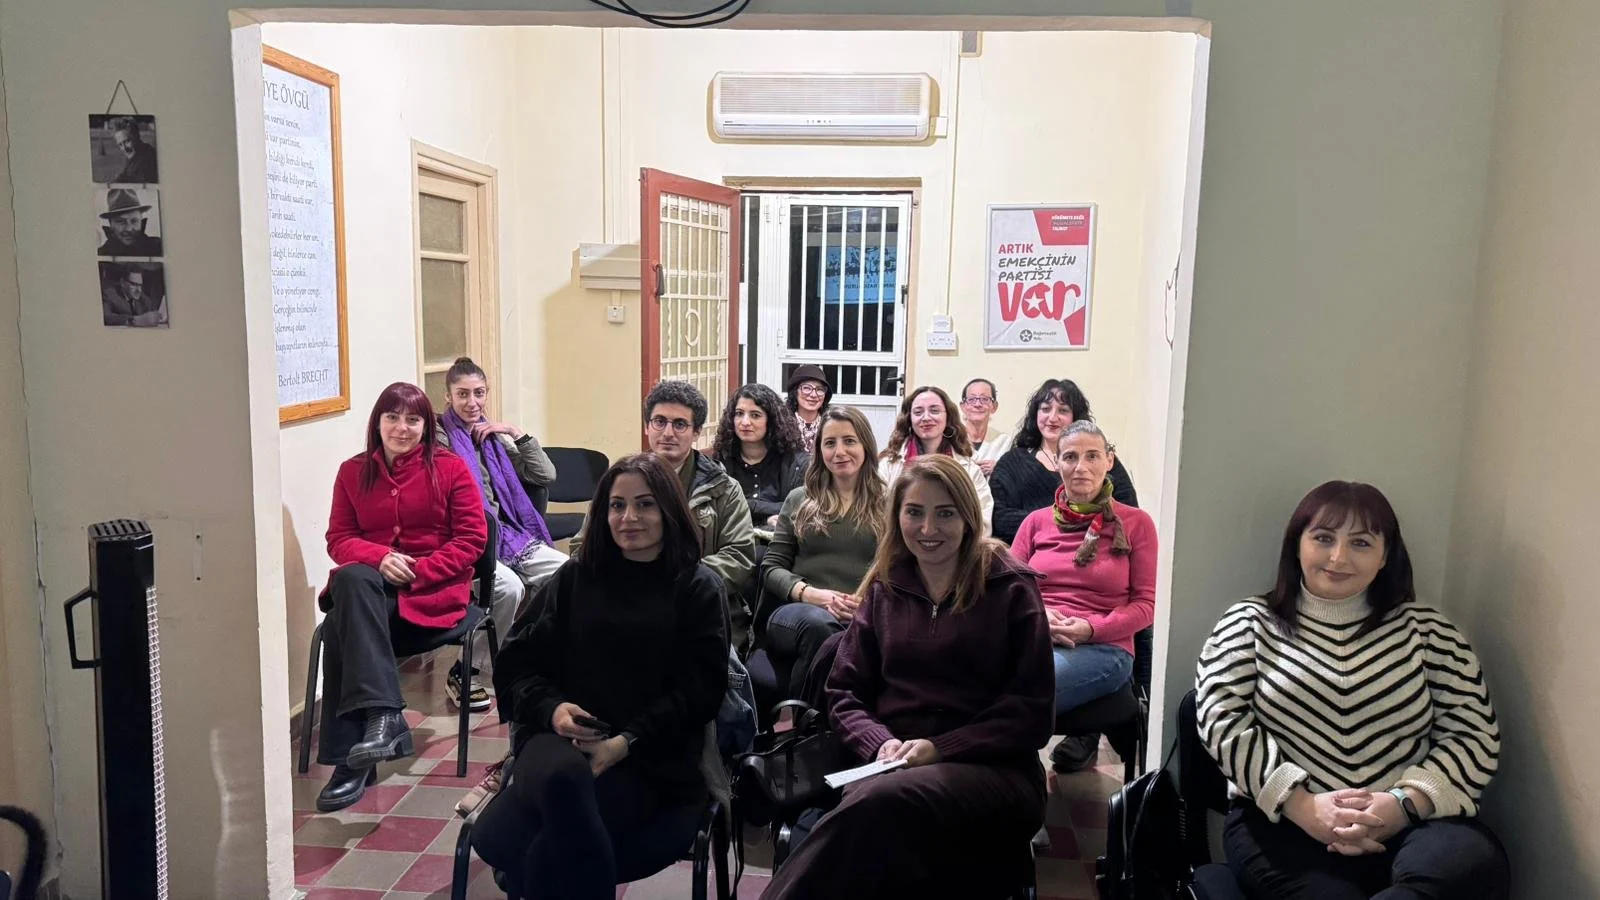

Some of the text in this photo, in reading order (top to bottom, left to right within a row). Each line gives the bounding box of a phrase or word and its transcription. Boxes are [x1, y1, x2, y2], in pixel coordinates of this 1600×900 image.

[263, 77, 309, 110] İYE ÖVGÜ
[282, 172, 289, 183] de
[290, 172, 304, 188] biliyor
[998, 243, 1034, 254] ARTIK
[998, 253, 1077, 270] EMEKÇİNİN
[998, 267, 1053, 281] PARTİSİ
[278, 369, 328, 387] Bertolt BRECHT
